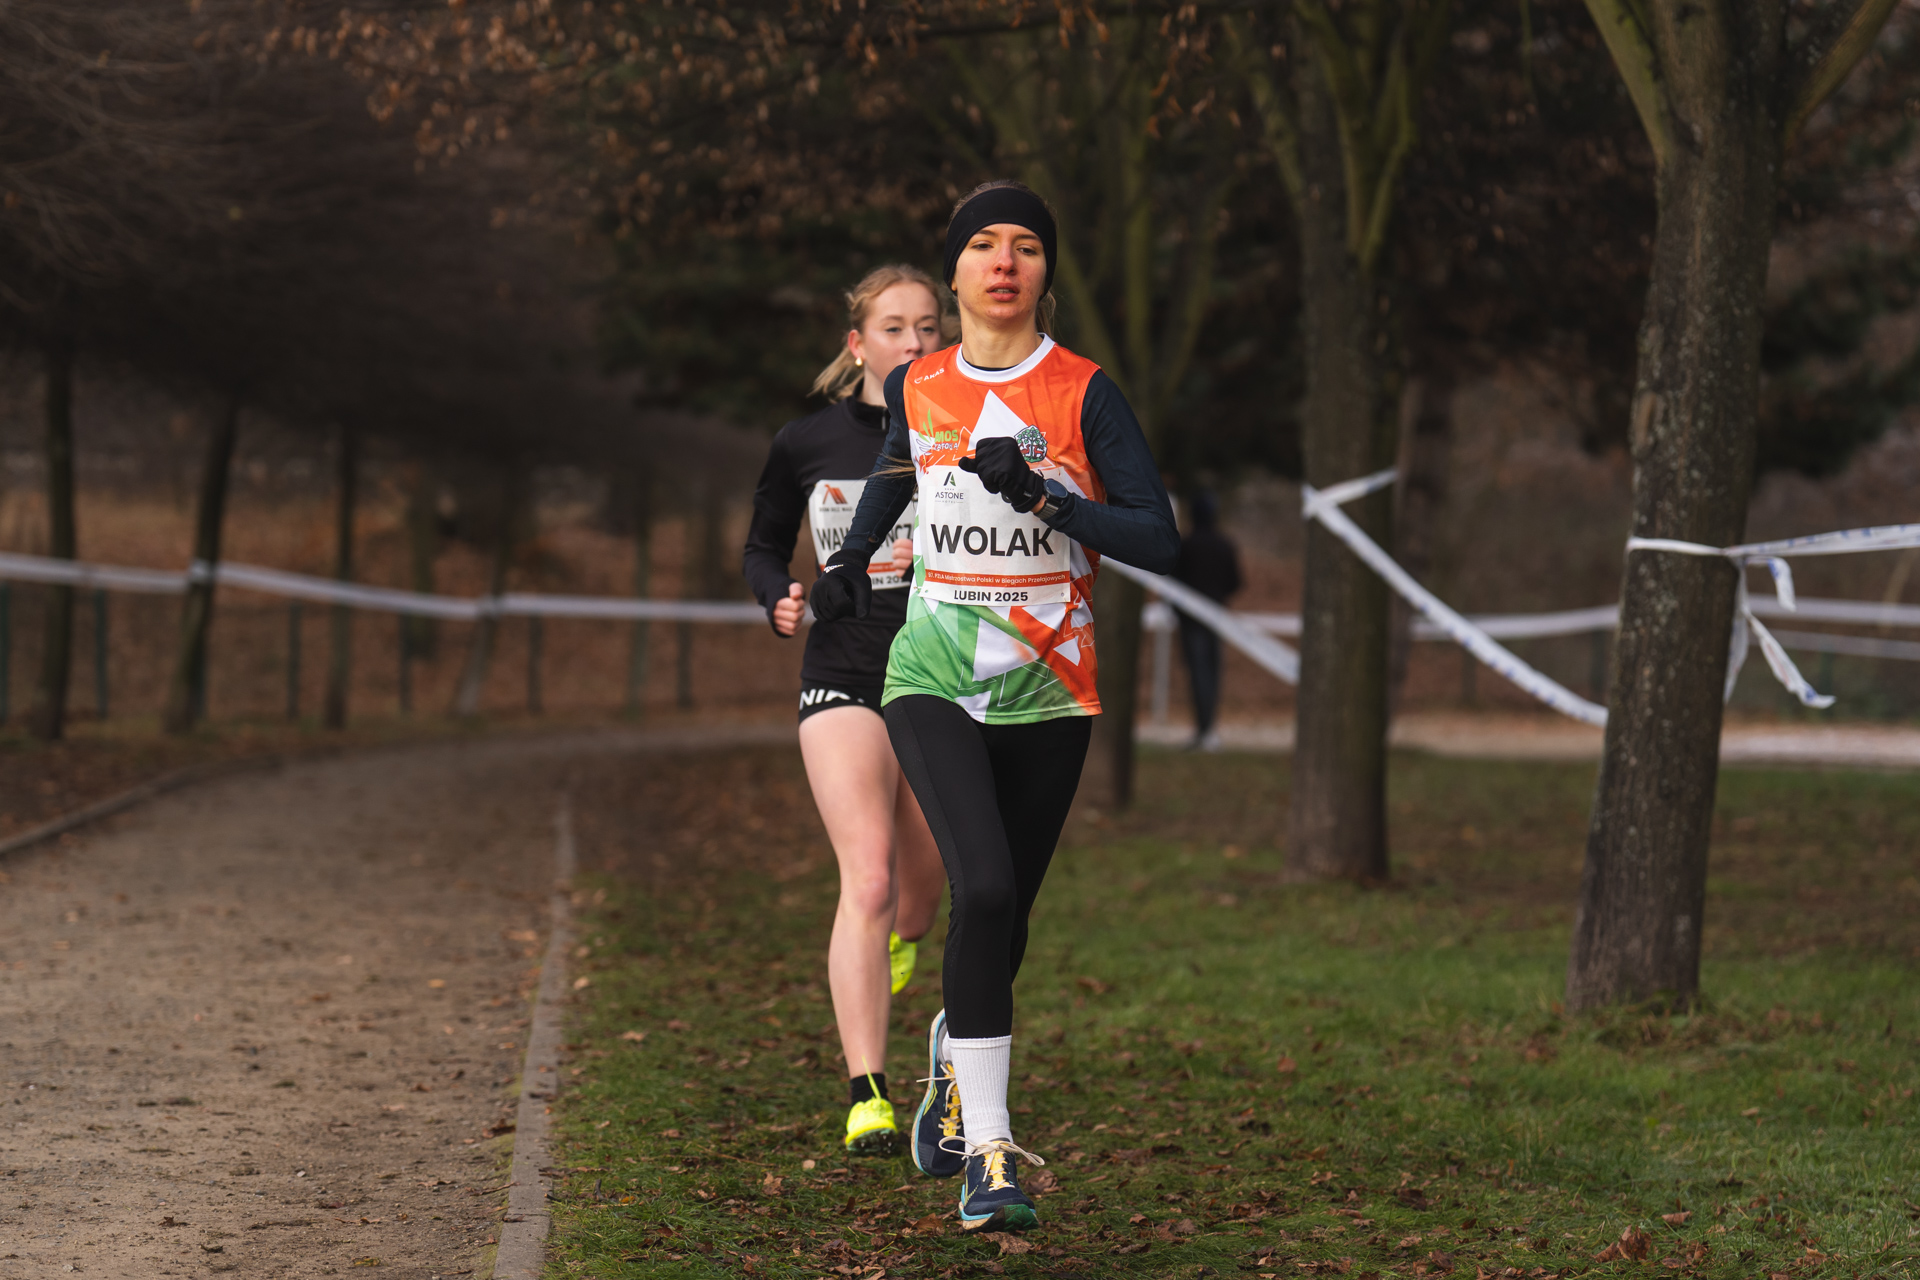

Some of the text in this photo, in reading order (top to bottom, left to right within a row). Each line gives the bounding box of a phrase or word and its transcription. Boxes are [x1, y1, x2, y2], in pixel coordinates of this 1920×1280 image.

[935, 430, 958, 442] MOS
[935, 491, 964, 500] ASTONE
[930, 523, 1054, 557] WOLAK
[944, 574, 976, 583] Mistrzostwa
[1001, 577, 1027, 585] Biegach
[954, 589, 1028, 602] LUBIN 2025
